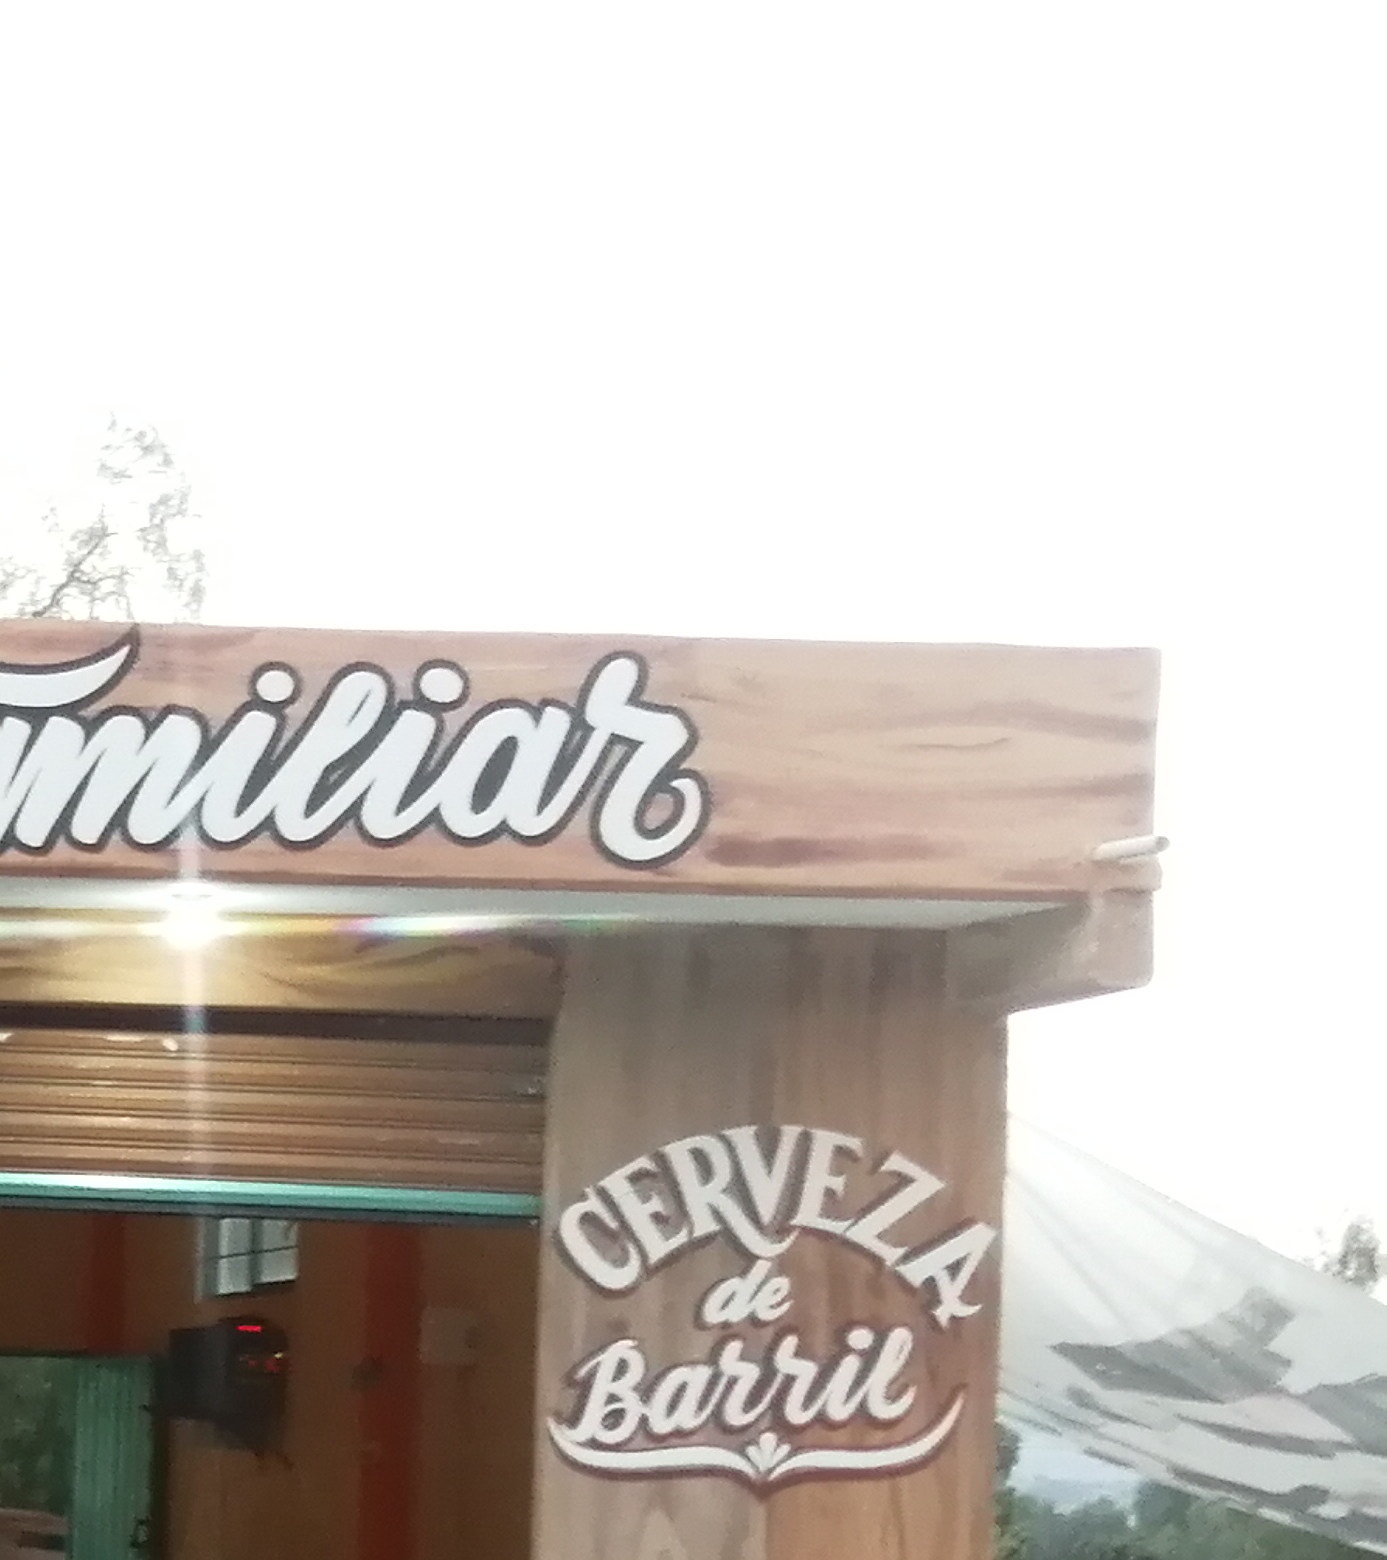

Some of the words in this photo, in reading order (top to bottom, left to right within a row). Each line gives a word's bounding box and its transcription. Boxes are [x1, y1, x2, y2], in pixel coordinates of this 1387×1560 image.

[555, 1124, 997, 1328] CERVEZA
[699, 1258, 795, 1325] de
[565, 1326, 919, 1446] Barril
